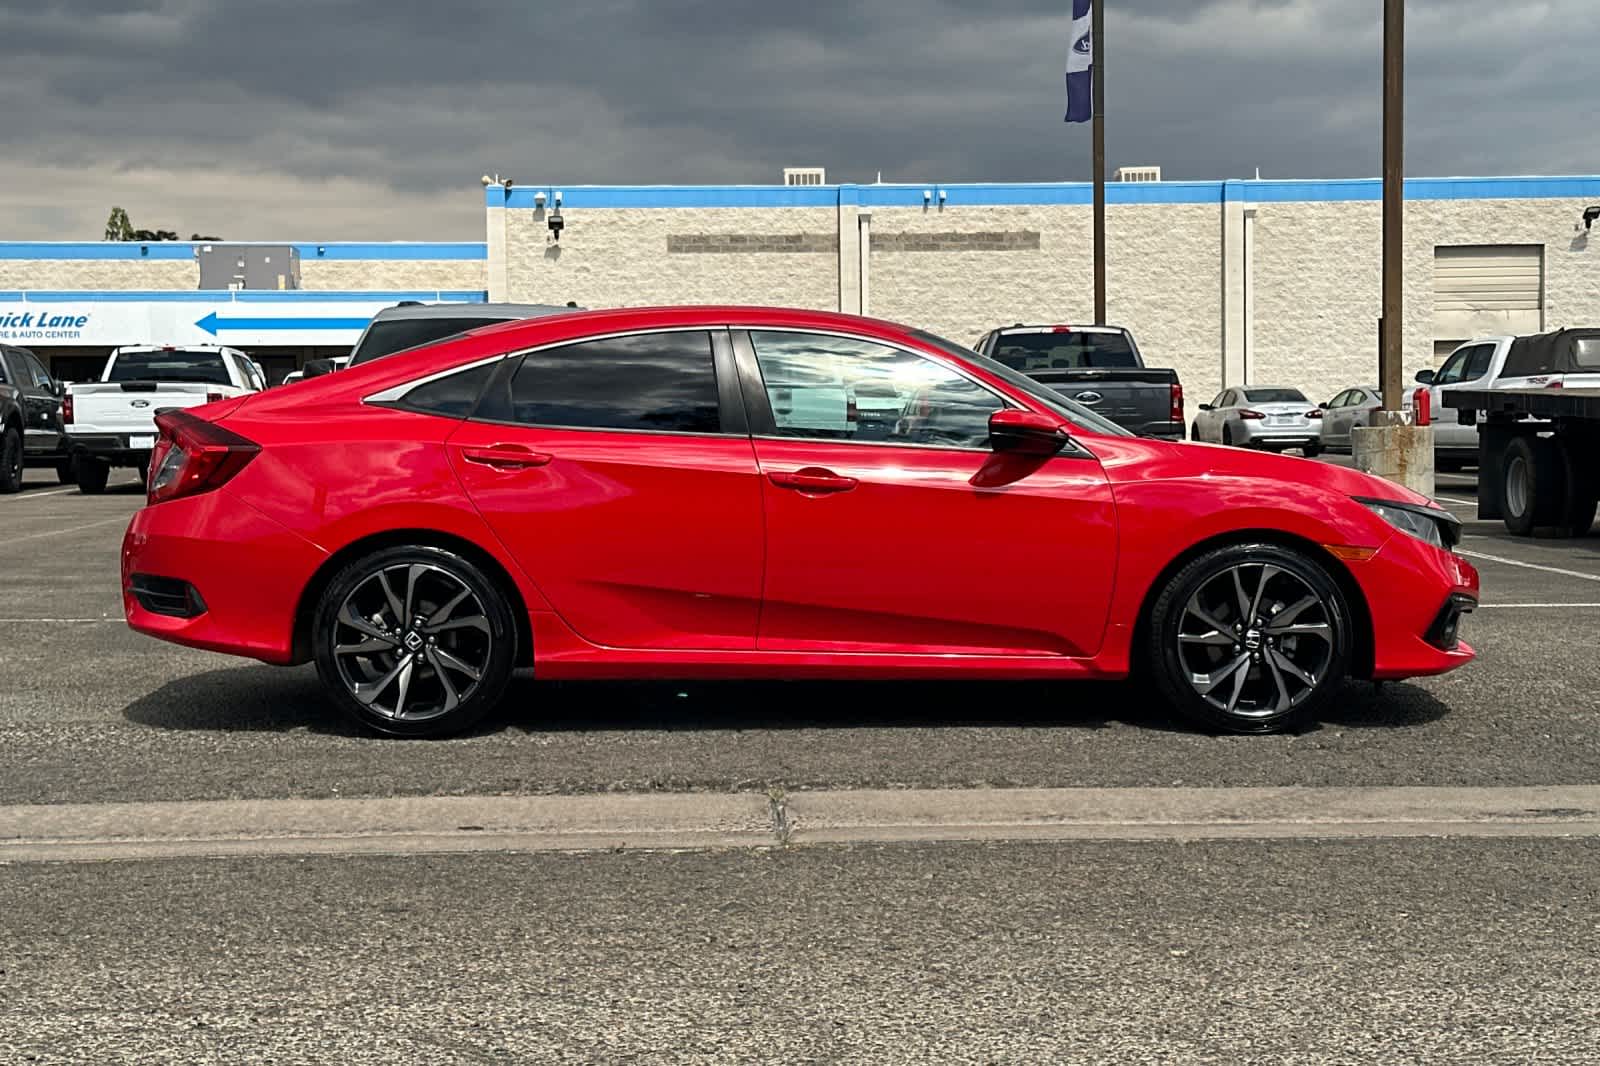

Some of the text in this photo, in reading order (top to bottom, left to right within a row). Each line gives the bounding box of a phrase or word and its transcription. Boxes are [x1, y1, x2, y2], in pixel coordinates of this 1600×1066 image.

[0, 312, 88, 328] ick Lane
[12, 331, 17, 339] &
[19, 331, 43, 339] AUTO
[45, 331, 80, 339] CENTER
